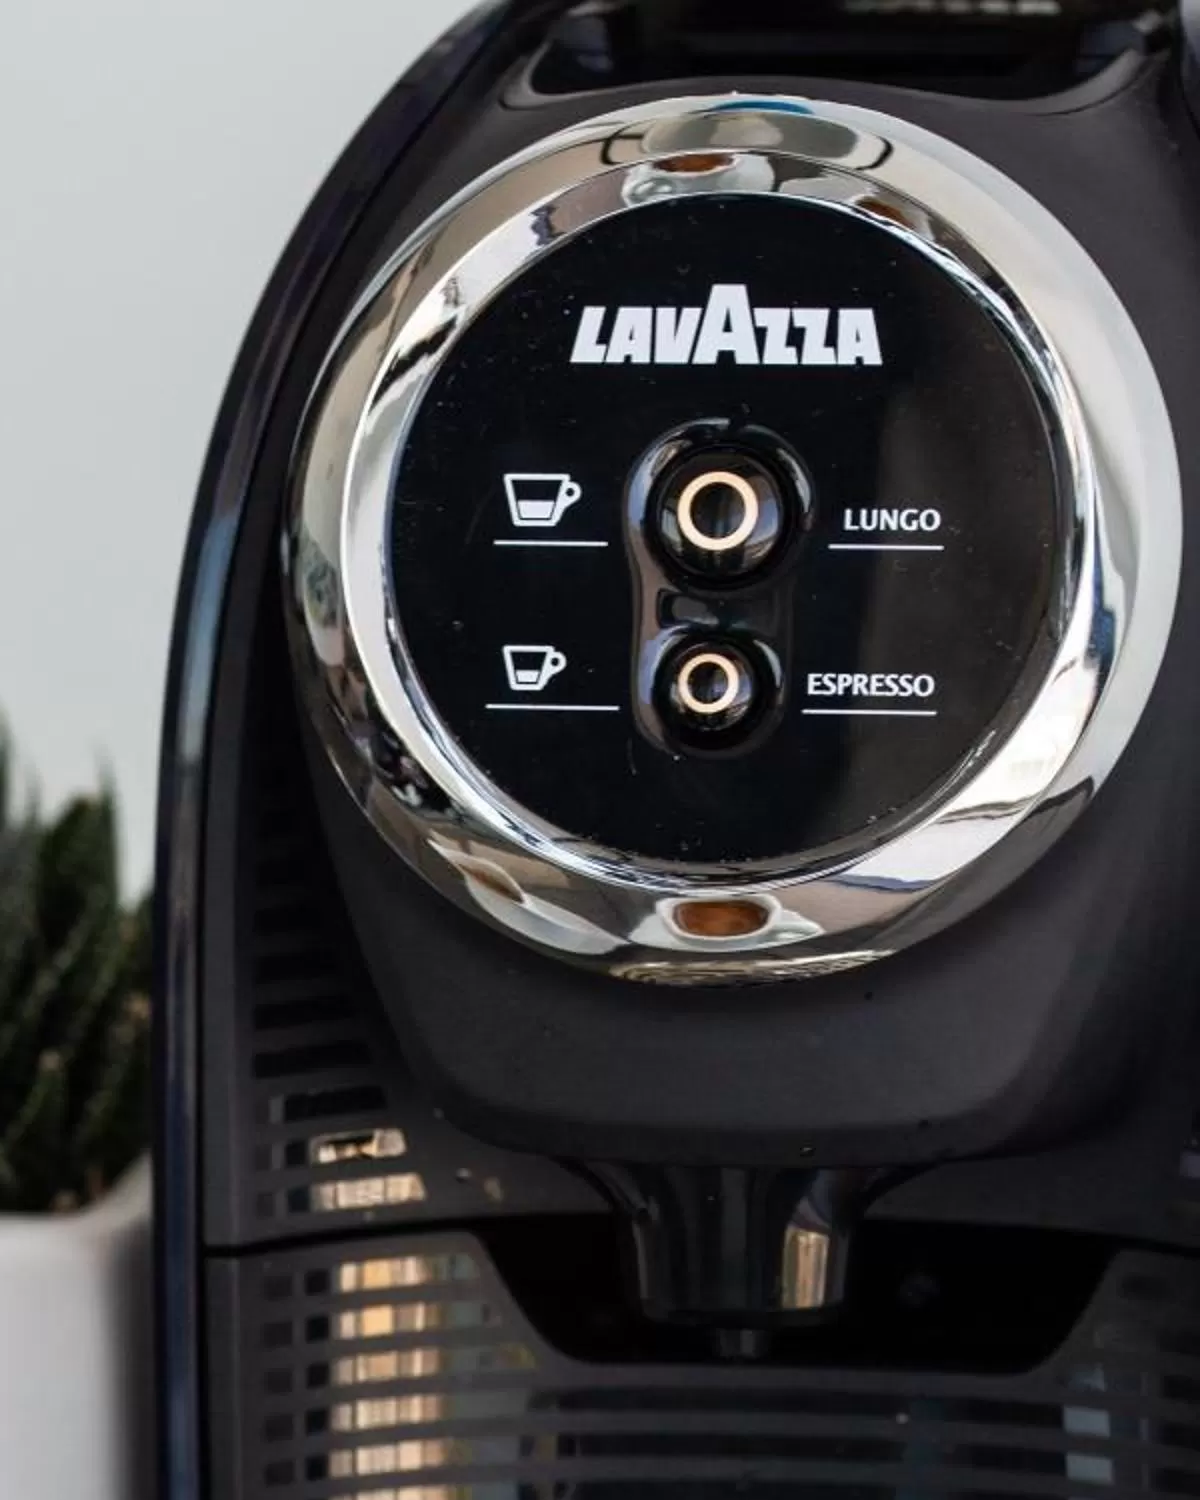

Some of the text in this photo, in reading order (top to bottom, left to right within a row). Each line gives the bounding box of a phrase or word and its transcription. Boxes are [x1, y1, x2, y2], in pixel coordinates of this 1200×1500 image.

[569, 283, 883, 366] LAVAZZA
[843, 508, 942, 532] LUNGO
[806, 672, 936, 698] ESPRESSO
